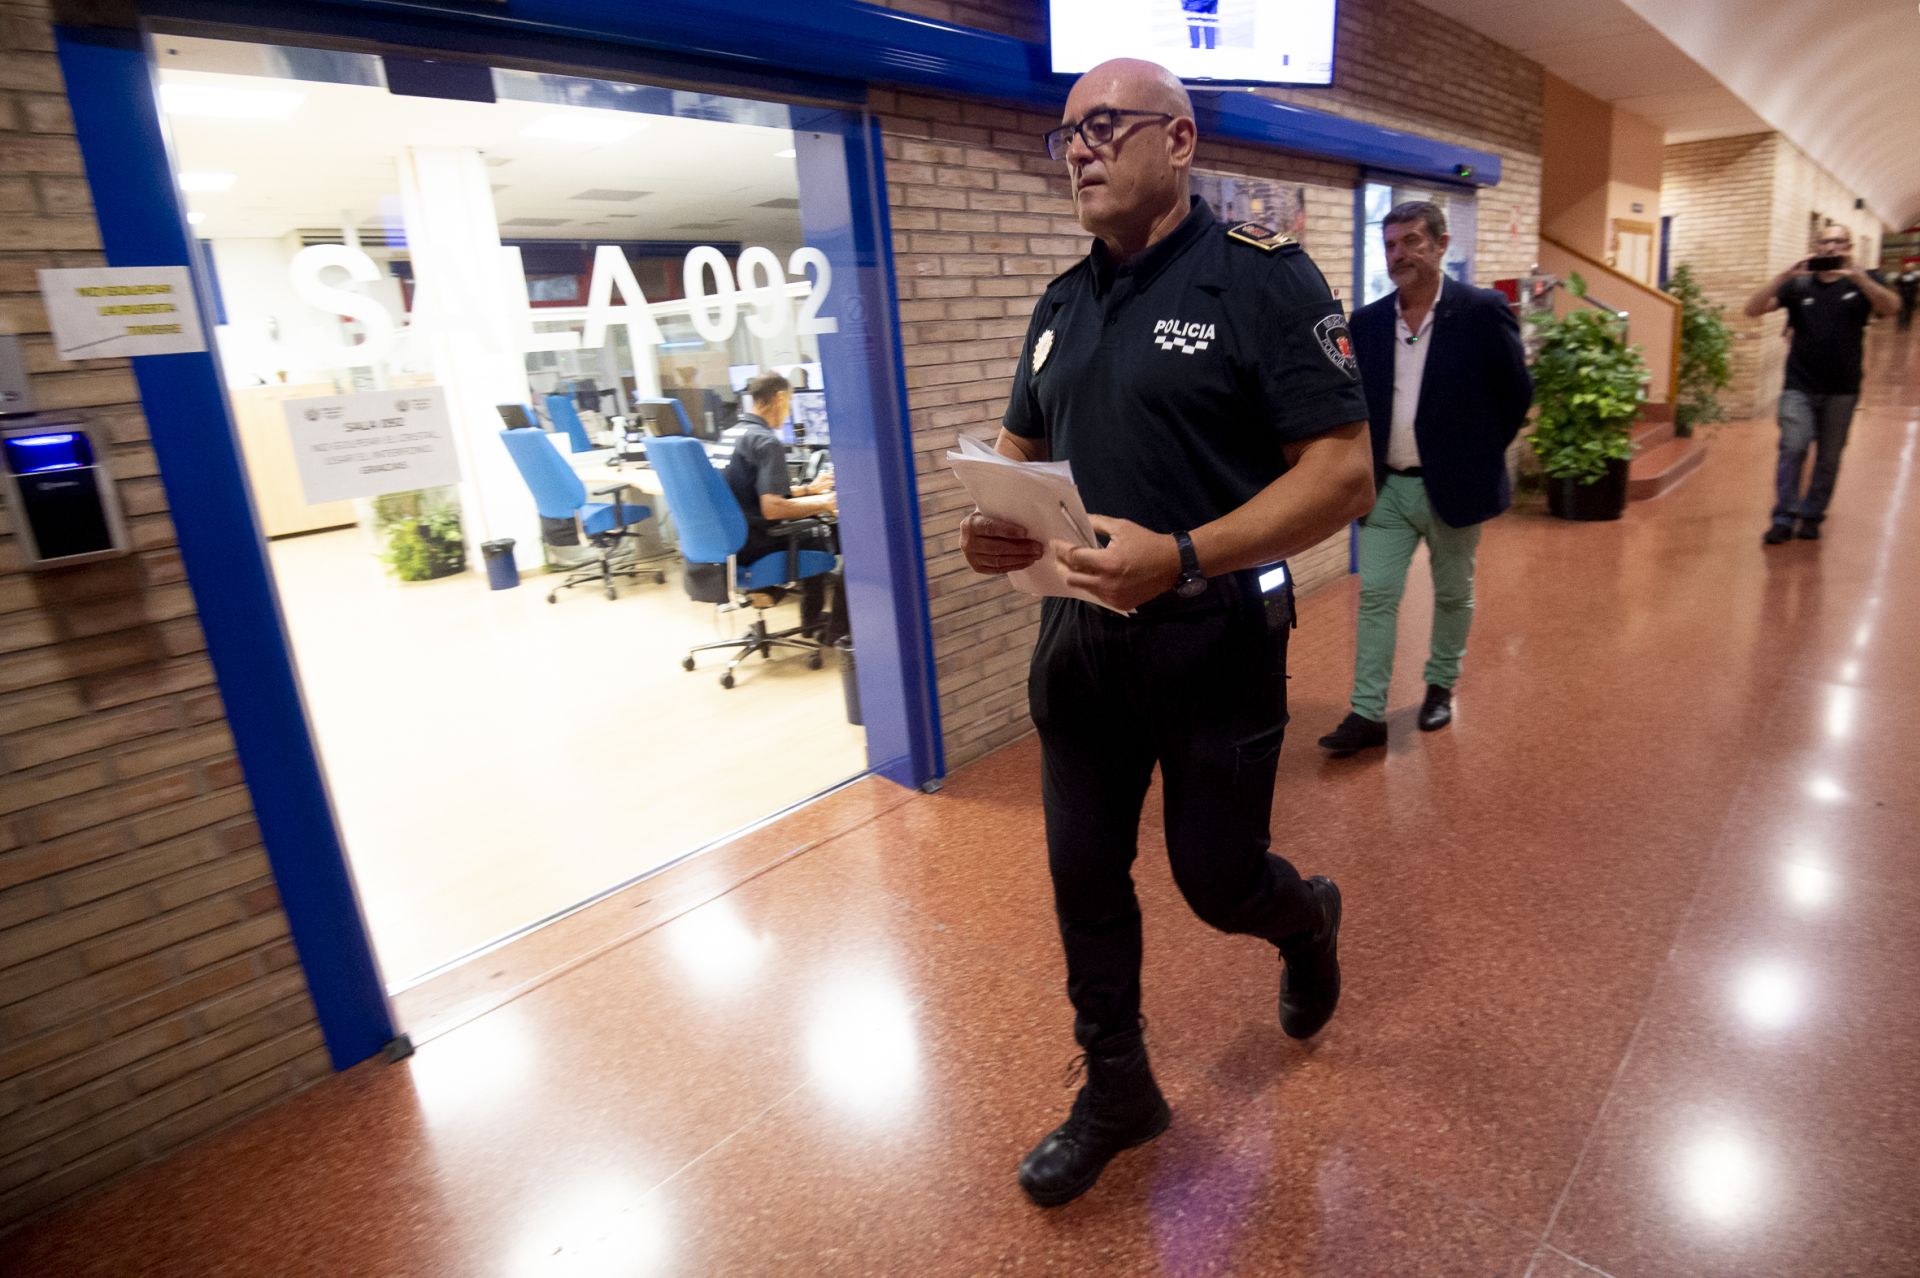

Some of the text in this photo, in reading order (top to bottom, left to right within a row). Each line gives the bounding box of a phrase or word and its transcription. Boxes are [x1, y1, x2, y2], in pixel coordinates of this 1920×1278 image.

[289, 243, 839, 367] SLA 092
[1153, 318, 1216, 340] POLICIA
[1321, 338, 1346, 368] POLICIA
